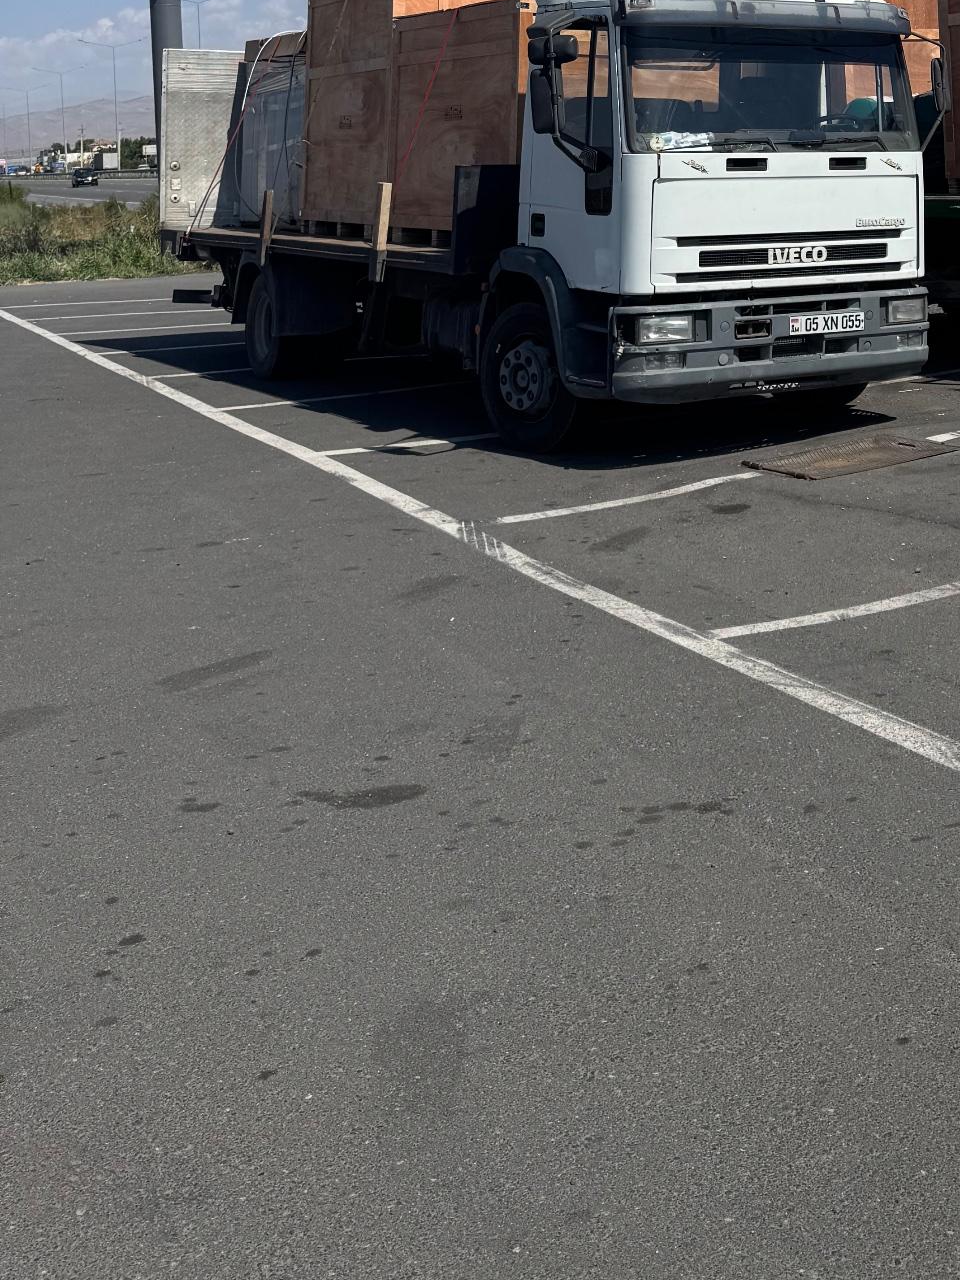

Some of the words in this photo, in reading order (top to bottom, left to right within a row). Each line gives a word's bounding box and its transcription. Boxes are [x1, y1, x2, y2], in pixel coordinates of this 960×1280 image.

[767, 246, 828, 265] IVECO
[805, 317, 819, 332] 05
[822, 315, 839, 331] XN
[841, 314, 861, 329] 055
